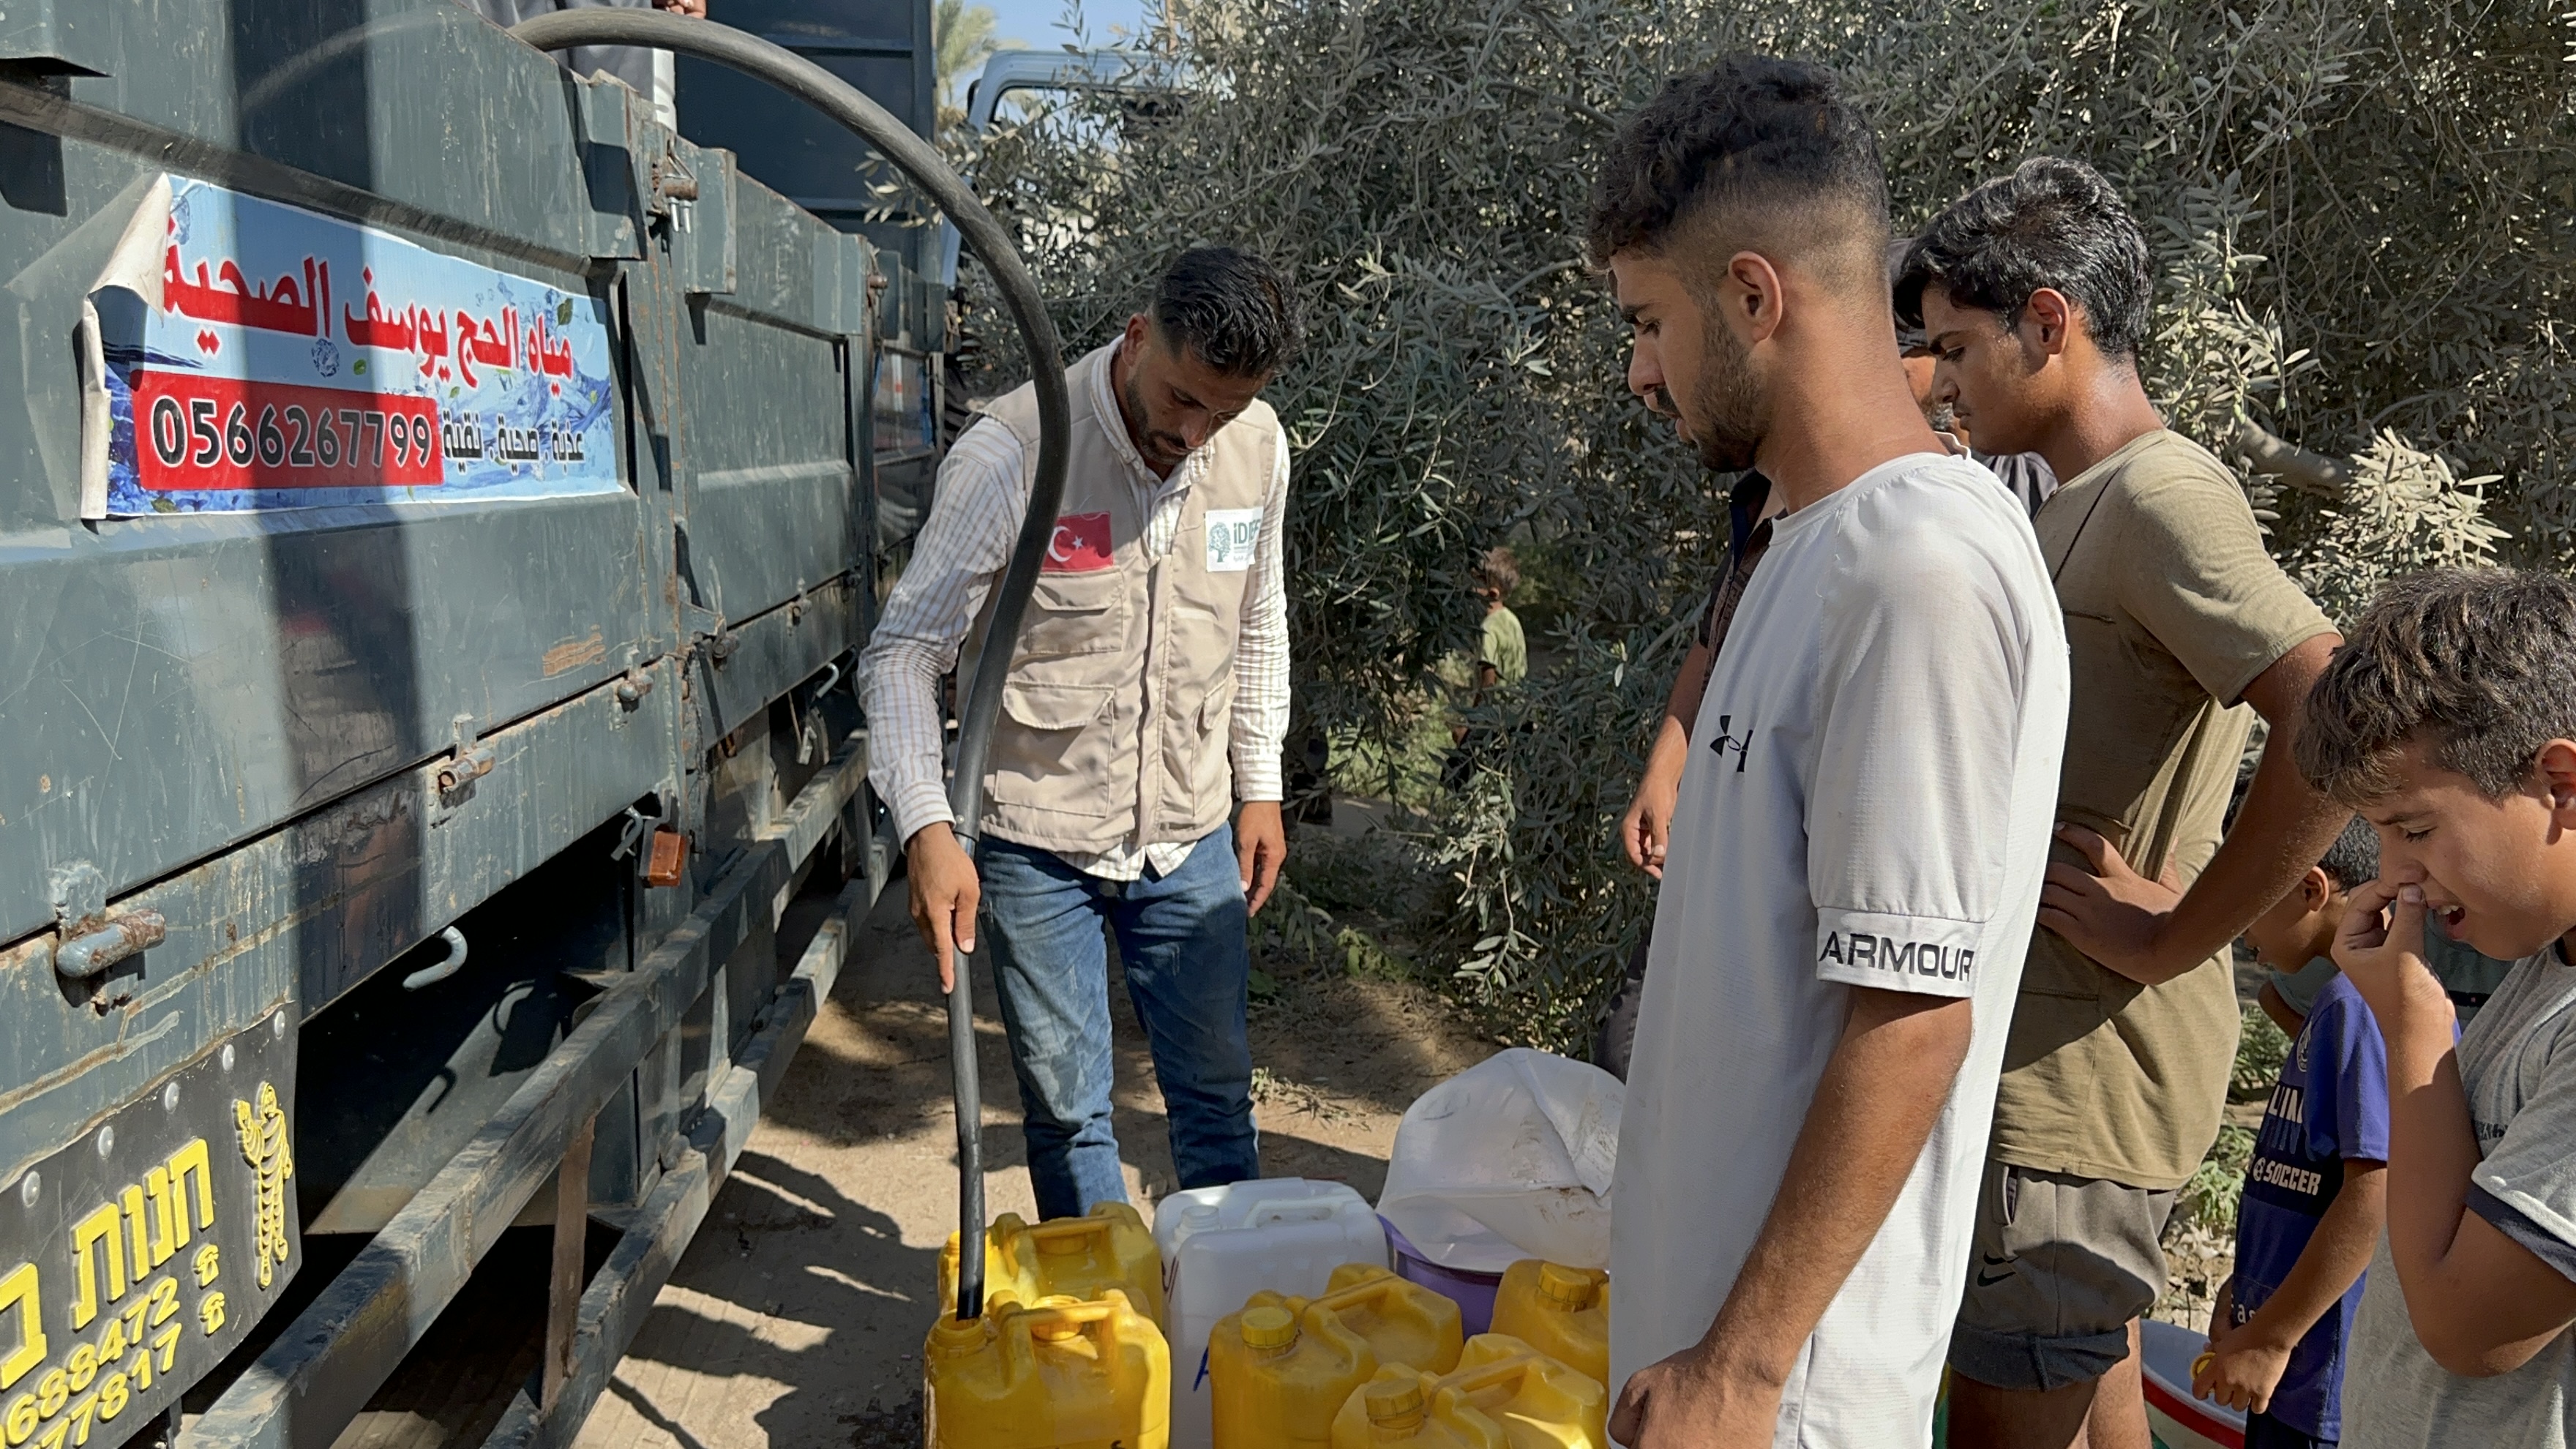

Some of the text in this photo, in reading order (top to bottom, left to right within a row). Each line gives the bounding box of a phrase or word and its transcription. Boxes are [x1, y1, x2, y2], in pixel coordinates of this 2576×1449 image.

[344, 266, 452, 383] يوسف
[457, 305, 520, 389] الحج
[528, 314, 573, 397] مياه
[151, 395, 433, 468] 0566267799
[443, 410, 483, 473] نقية
[498, 414, 539, 474] صحية
[552, 420, 585, 473] عذبة
[1819, 931, 1974, 981] ARMOUR
[2263, 1159, 2321, 1196] SOCCER
[72, 1138, 214, 1330] חנות
[0, 1276, 180, 1449] 688472
[32, 1322, 182, 1449] 77817
